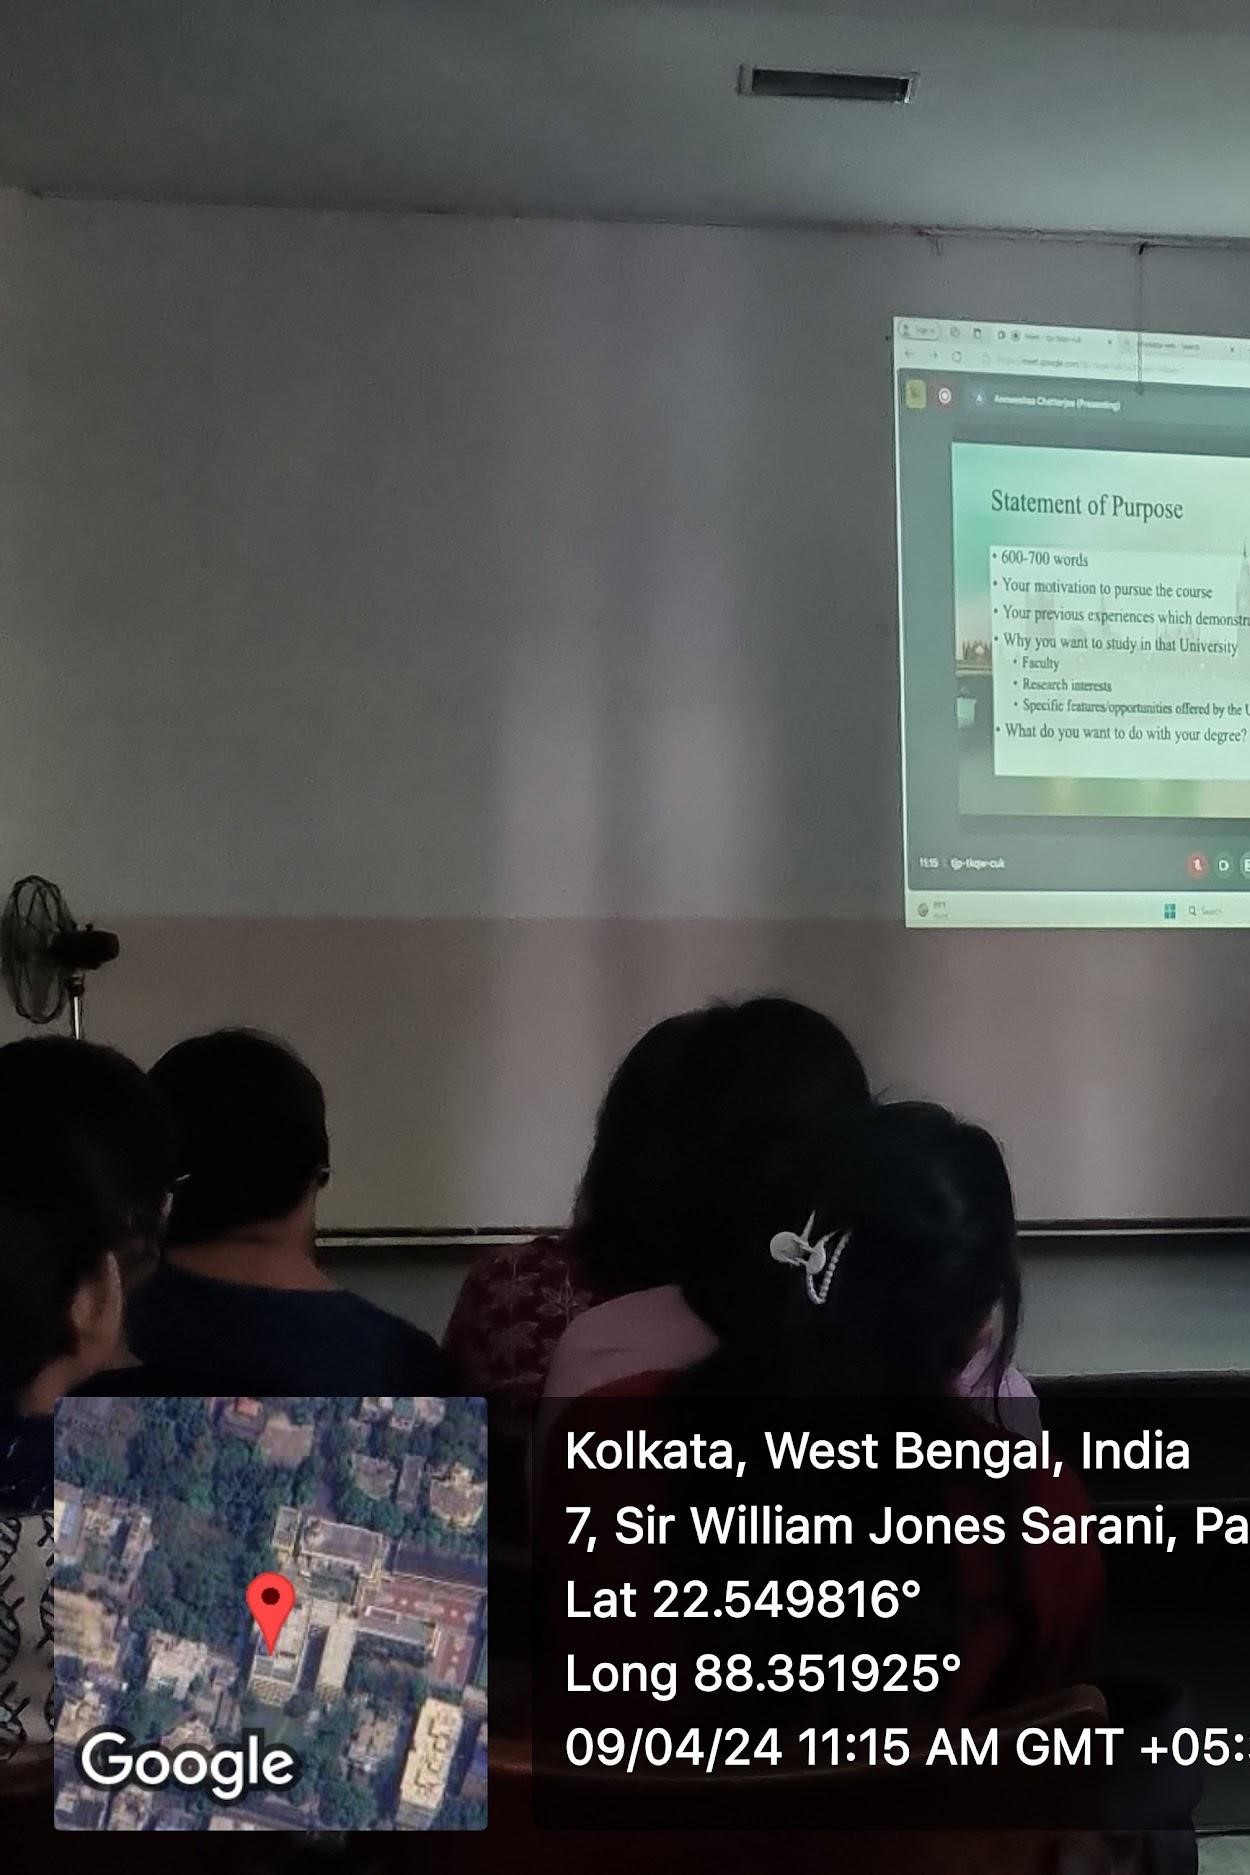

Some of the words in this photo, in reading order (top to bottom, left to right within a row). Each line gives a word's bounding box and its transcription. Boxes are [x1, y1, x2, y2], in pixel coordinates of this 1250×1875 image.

[991, 489, 1082, 515] Statement
[1088, 494, 1109, 516] of
[1112, 494, 1184, 523] Purpose
[1001, 550, 1050, 565] 600-700
[1053, 552, 1089, 567] words
[1002, 577, 1031, 593] Your
[1034, 579, 1096, 595] motivation
[1100, 582, 1111, 596] to
[1114, 585, 1153, 600] pursue
[1156, 583, 1173, 599] the
[1176, 586, 1213, 599] course
[1002, 604, 1032, 620] Your
[1034, 607, 1085, 623] previous
[1088, 610, 1155, 626] experiences
[1158, 609, 1192, 625] which
[1003, 632, 1032, 651] Why
[1035, 637, 1056, 651] you
[1060, 636, 1088, 650] want
[1091, 637, 1103, 650] to
[1106, 637, 1137, 654] study
[1140, 637, 1151, 651] in
[1155, 637, 1176, 651] that
[1179, 638, 1239, 657] University
[1022, 655, 1060, 672] Faculty
[1022, 677, 1068, 691] Research
[1071, 679, 1112, 692] interests
[1022, 698, 1064, 714] Specific
[1067, 699, 1173, 716] features/opportunities
[1175, 702, 1209, 716] offered
[1212, 702, 1224, 718] by
[1227, 702, 1242, 716] the
[1005, 722, 1036, 738] What
[1040, 723, 1055, 738] do
[1058, 727, 1080, 741] you
[1083, 726, 1110, 740] want
[1114, 727, 1126, 740] to
[1128, 725, 1143, 740] do
[1146, 725, 1171, 740] with
[1175, 729, 1201, 744] your
[1203, 728, 1247, 745] degree?
